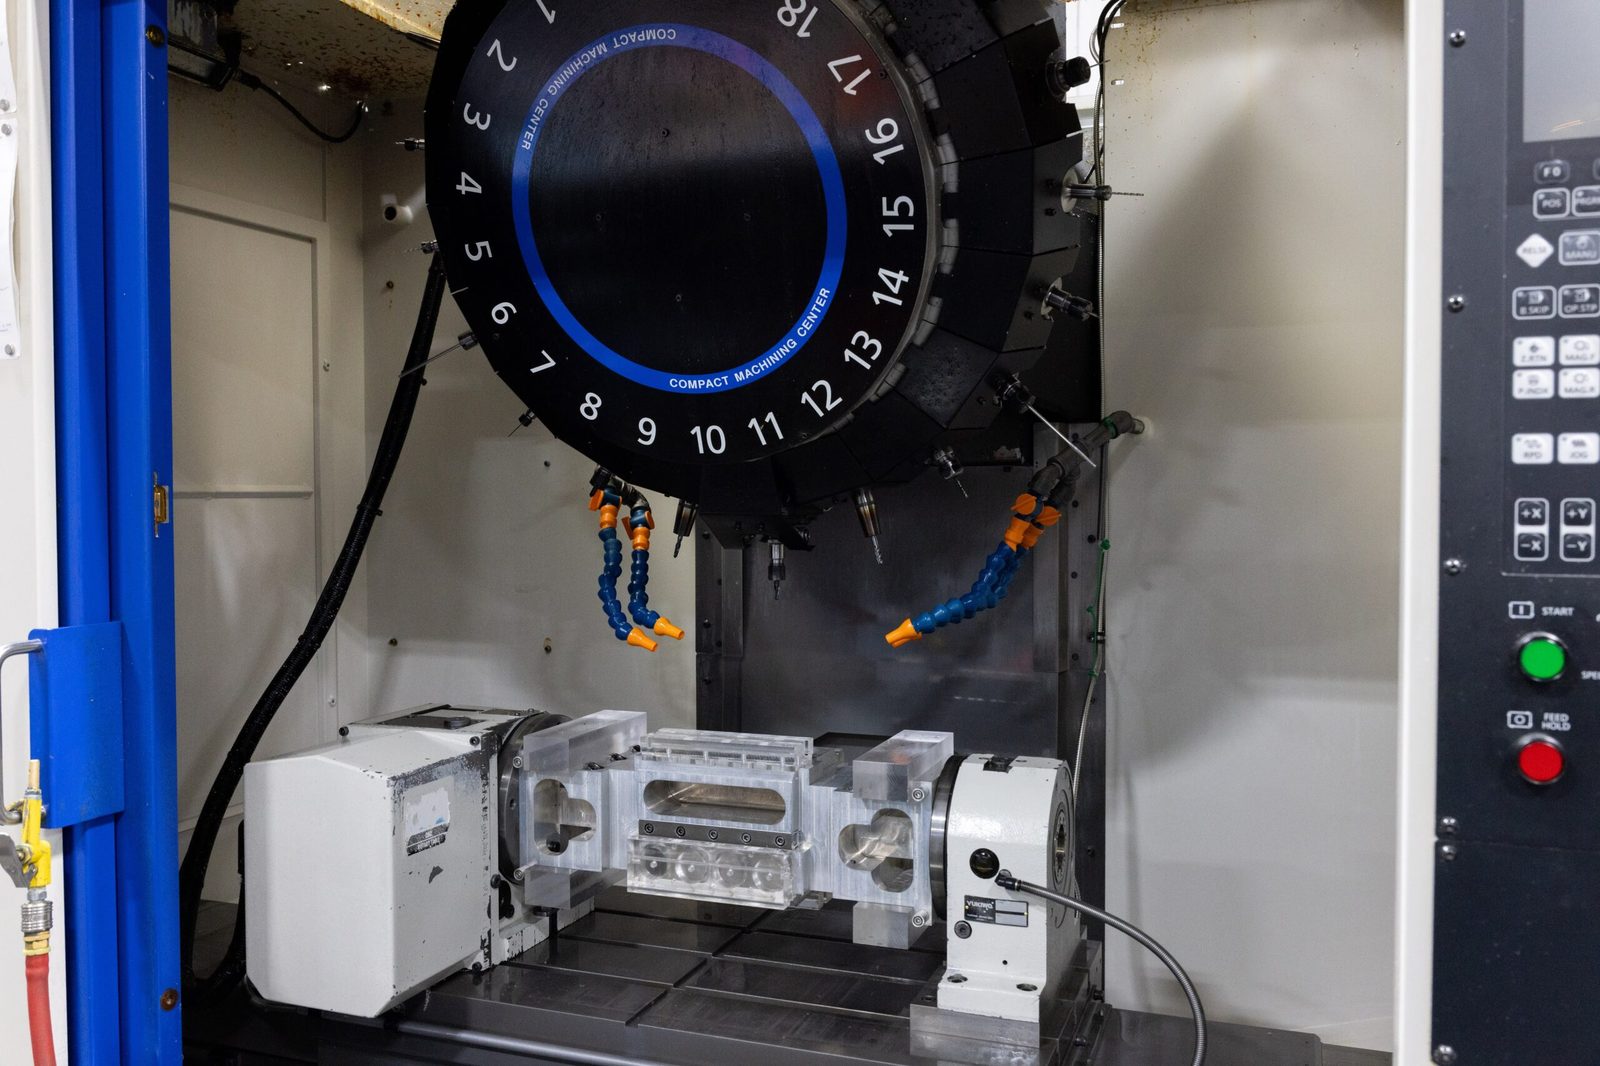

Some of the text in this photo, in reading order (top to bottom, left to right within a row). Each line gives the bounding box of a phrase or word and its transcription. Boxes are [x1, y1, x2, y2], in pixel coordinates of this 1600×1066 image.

[776, 0, 819, 38] 18
[486, 38, 518, 72] 2
[521, 28, 677, 150] COMPACT MACHINING CENTER
[826, 54, 872, 96] 17
[463, 102, 491, 131] 3
[864, 117, 905, 165] 16
[455, 171, 482, 195] 4
[881, 195, 915, 238] 15
[464, 240, 493, 262] 5
[872, 267, 910, 306] 14
[490, 301, 518, 325] 6
[669, 287, 830, 389] COMPACT MACHINING CENTER
[843, 330, 882, 370] 13
[529, 349, 557, 375] 7
[579, 391, 603, 421] 8
[800, 379, 843, 418] 12
[637, 416, 657, 446] 9
[690, 424, 726, 455] 10
[747, 411, 784, 446] 11
[1541, 606, 1575, 617] START
[1541, 721, 1572, 731] HOLD
[1543, 712, 1570, 722] FEED
